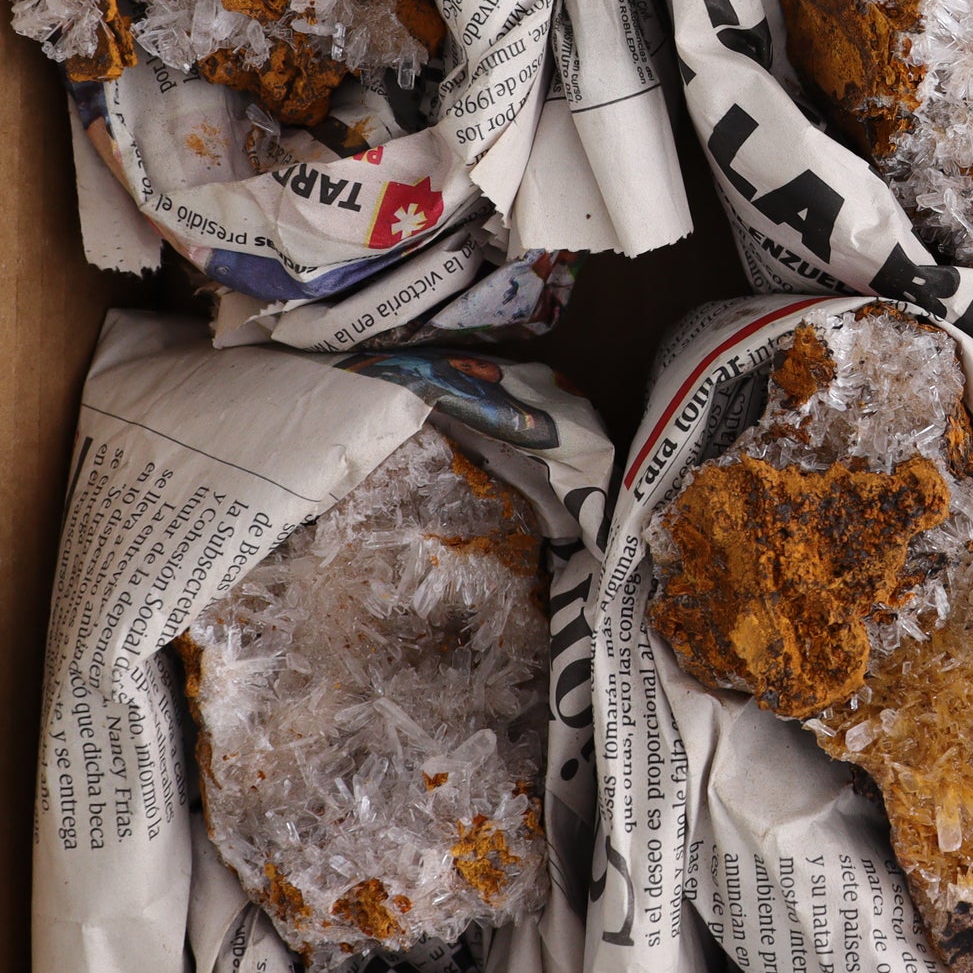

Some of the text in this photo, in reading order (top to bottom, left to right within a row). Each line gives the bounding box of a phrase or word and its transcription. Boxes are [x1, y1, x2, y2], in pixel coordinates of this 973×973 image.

[495, 76, 517, 96] de
[456, 124, 485, 144] los
[708, 104, 844, 264] LA
[177, 205, 247, 245] presidió
[351, 257, 464, 334] la victoria en
[122, 469, 174, 531] se lleva
[128, 486, 210, 587] titular de la
[152, 502, 176, 523] La
[227, 500, 249, 518] la
[123, 508, 217, 655] Cohesión Social
[217, 513, 272, 591] de Becas
[600, 535, 638, 612] Algunas
[602, 616, 618, 759] tomarán más
[619, 647, 636, 727] pero las
[55, 748, 77, 851] se entrega
[72, 703, 106, 851] que dicha beca
[106, 715, 133, 843] Nancy Frías.
[136, 743, 160, 822] informó
[640, 668, 665, 947] si el deseo es proporcional
[724, 852, 747, 940] anuncian
[754, 853, 776, 946] ambiente
[812, 875, 834, 956] su natal
[839, 854, 861, 972] siete países
[861, 857, 888, 952] marca de
[891, 884, 907, 941] sector
